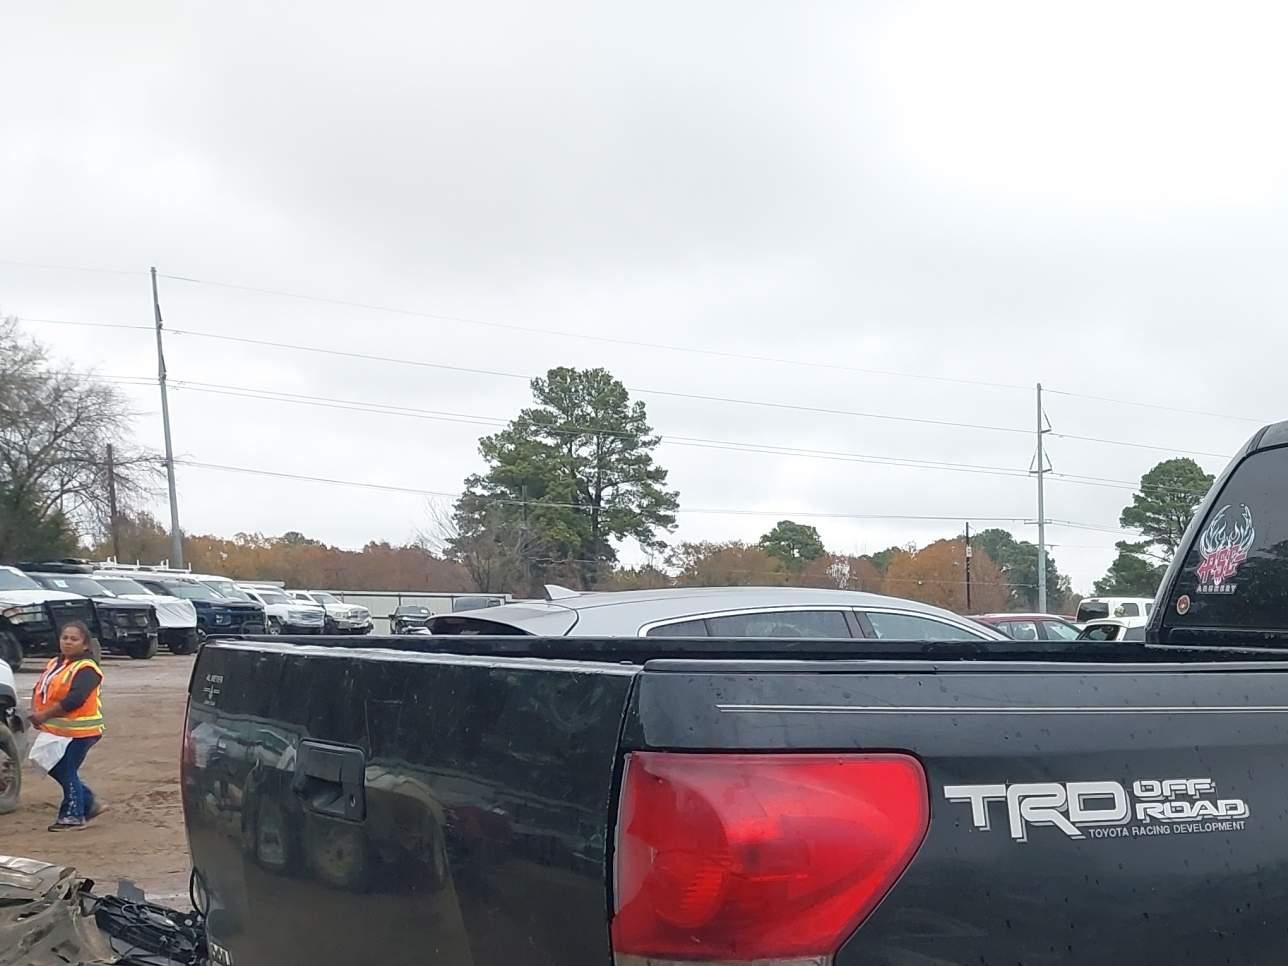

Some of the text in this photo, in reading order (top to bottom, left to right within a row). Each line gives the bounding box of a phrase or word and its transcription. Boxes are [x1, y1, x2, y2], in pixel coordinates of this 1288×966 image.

[1133, 778, 1216, 800] OFF
[943, 780, 1132, 842] TRD
[1135, 799, 1250, 823] ROAD
[1088, 821, 1246, 839] TOYOTA RACING DEVELOPMENT
